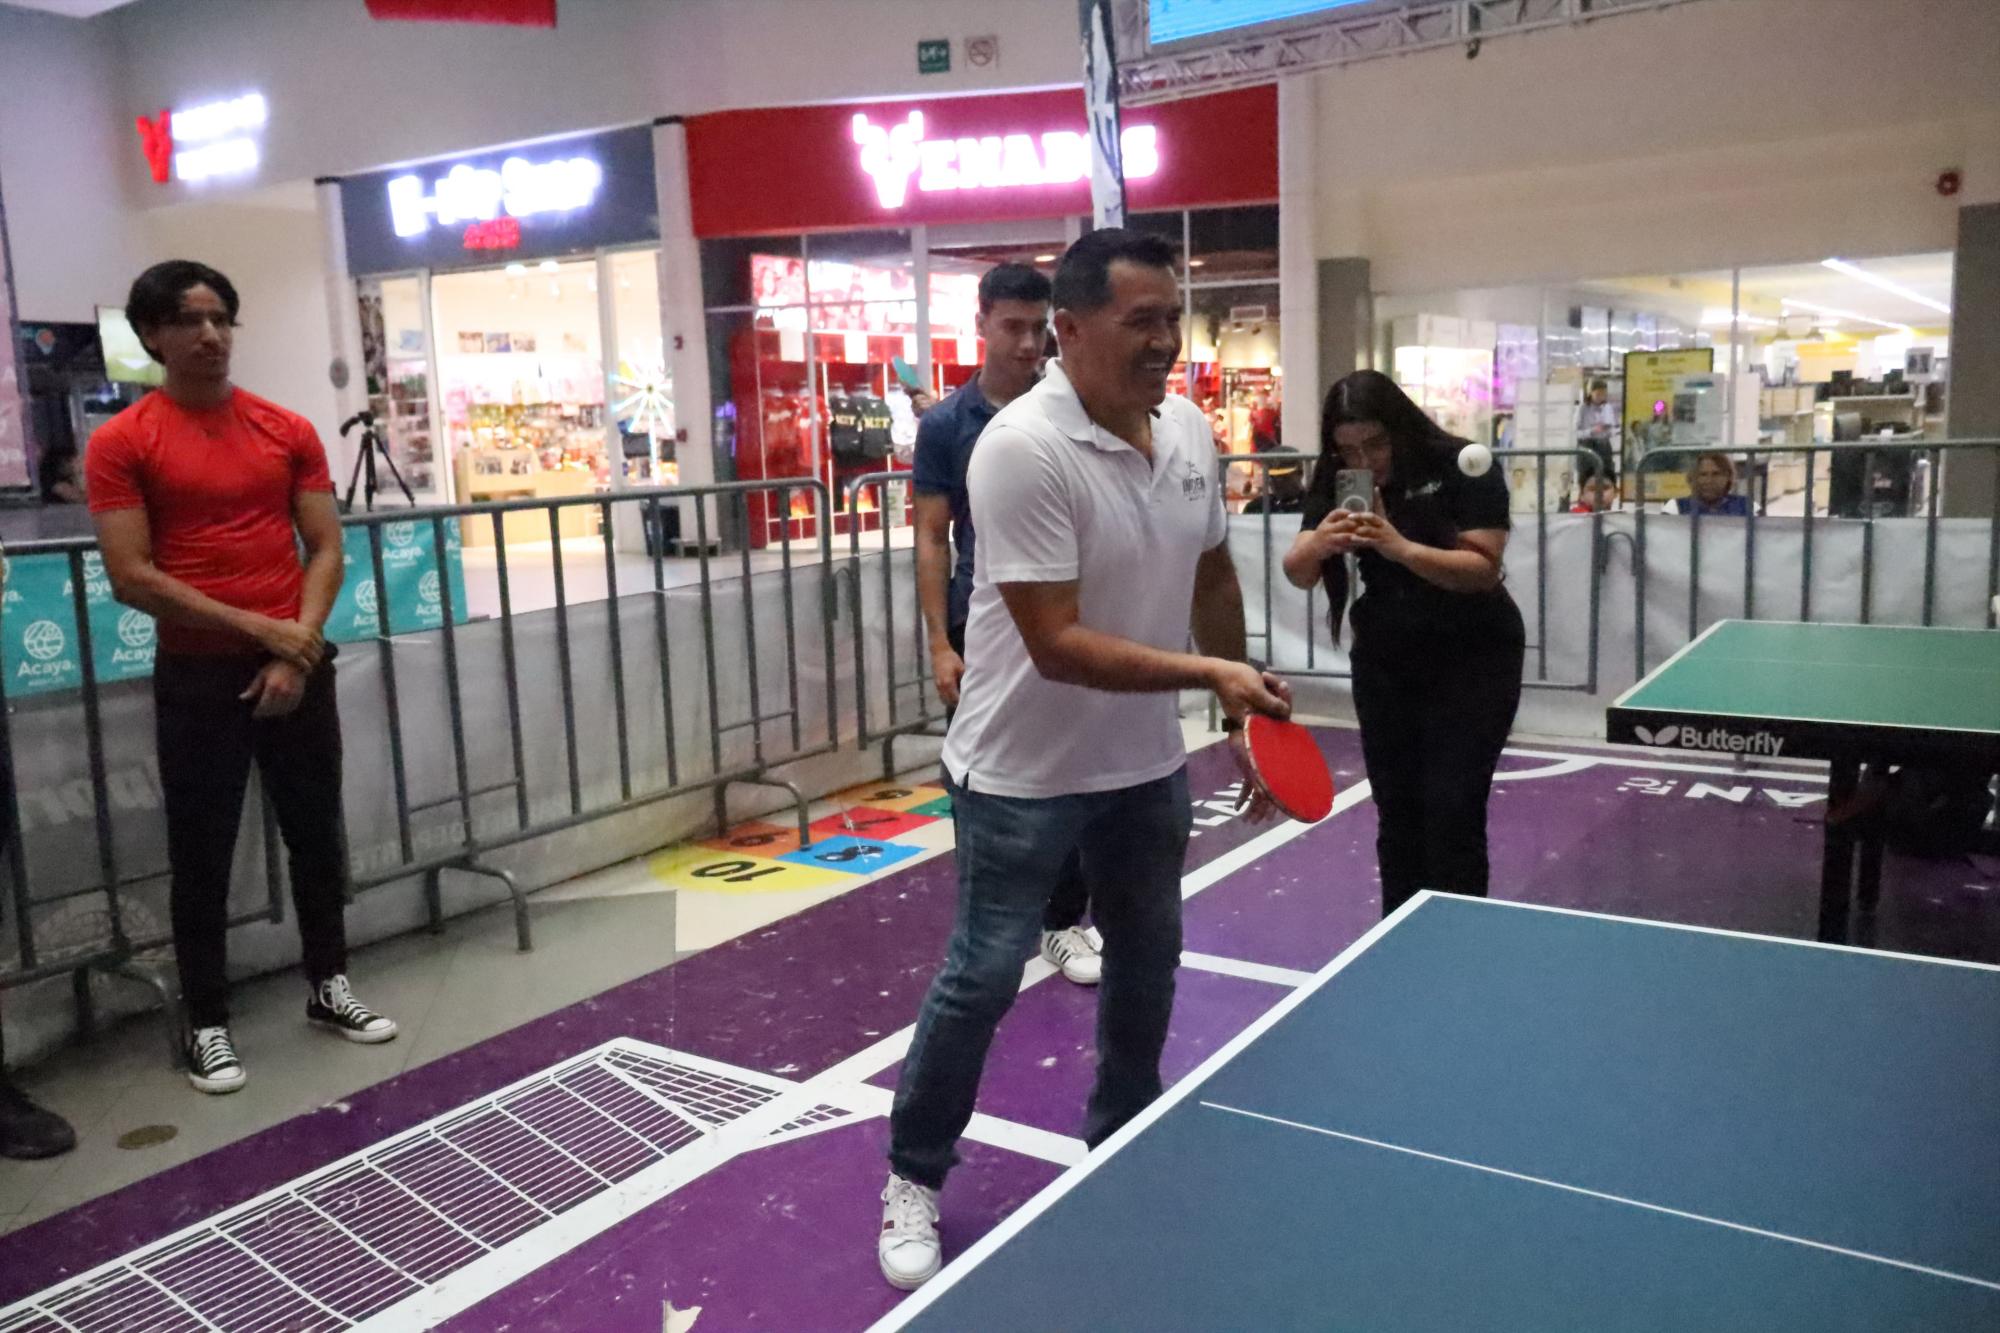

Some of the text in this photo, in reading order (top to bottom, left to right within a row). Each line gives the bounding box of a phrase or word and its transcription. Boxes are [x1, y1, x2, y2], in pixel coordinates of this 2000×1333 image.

[62, 579, 112, 597] Aaya
[112, 647, 155, 664] Acay
[1681, 727, 1784, 757] Butterfly
[691, 860, 786, 882] 10
